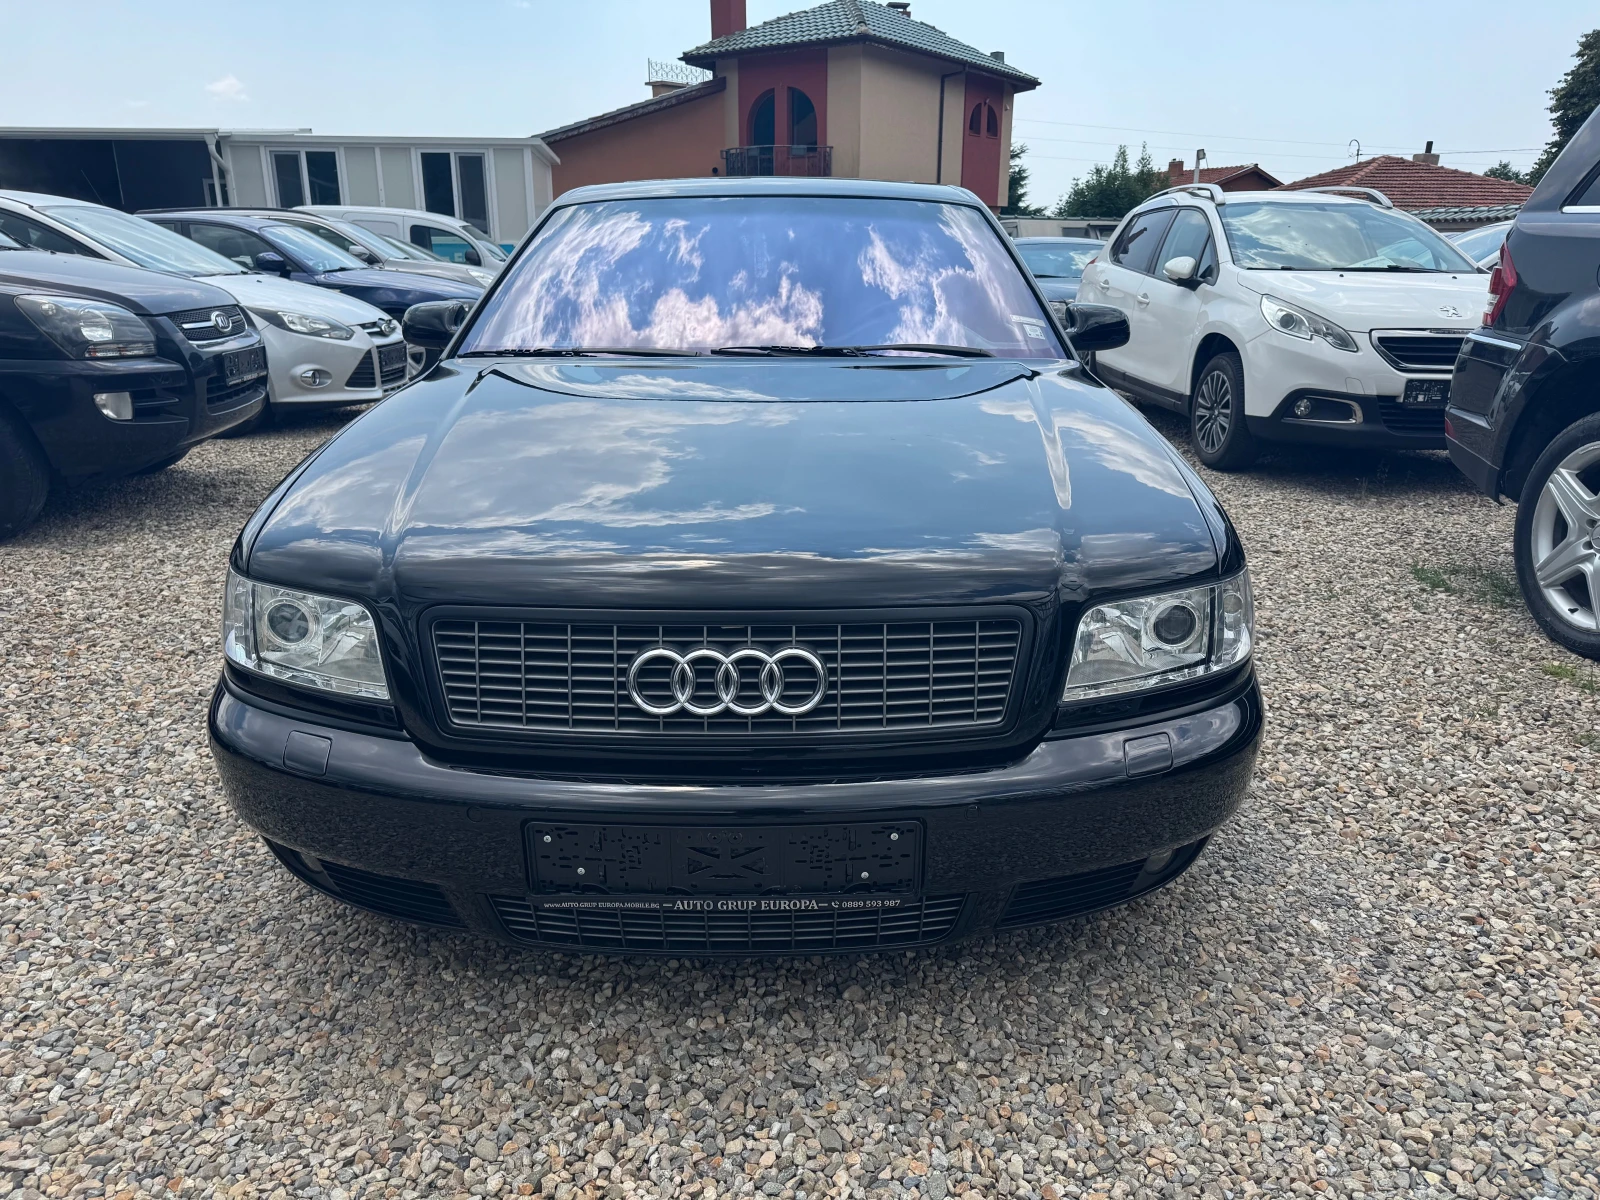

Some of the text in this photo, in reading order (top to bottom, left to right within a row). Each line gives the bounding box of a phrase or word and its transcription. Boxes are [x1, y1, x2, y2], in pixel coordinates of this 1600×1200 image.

[674, 900, 819, 911] AUTO GRUP EUROPA
[865, 900, 882, 908] 593
[884, 899, 901, 907] 987
